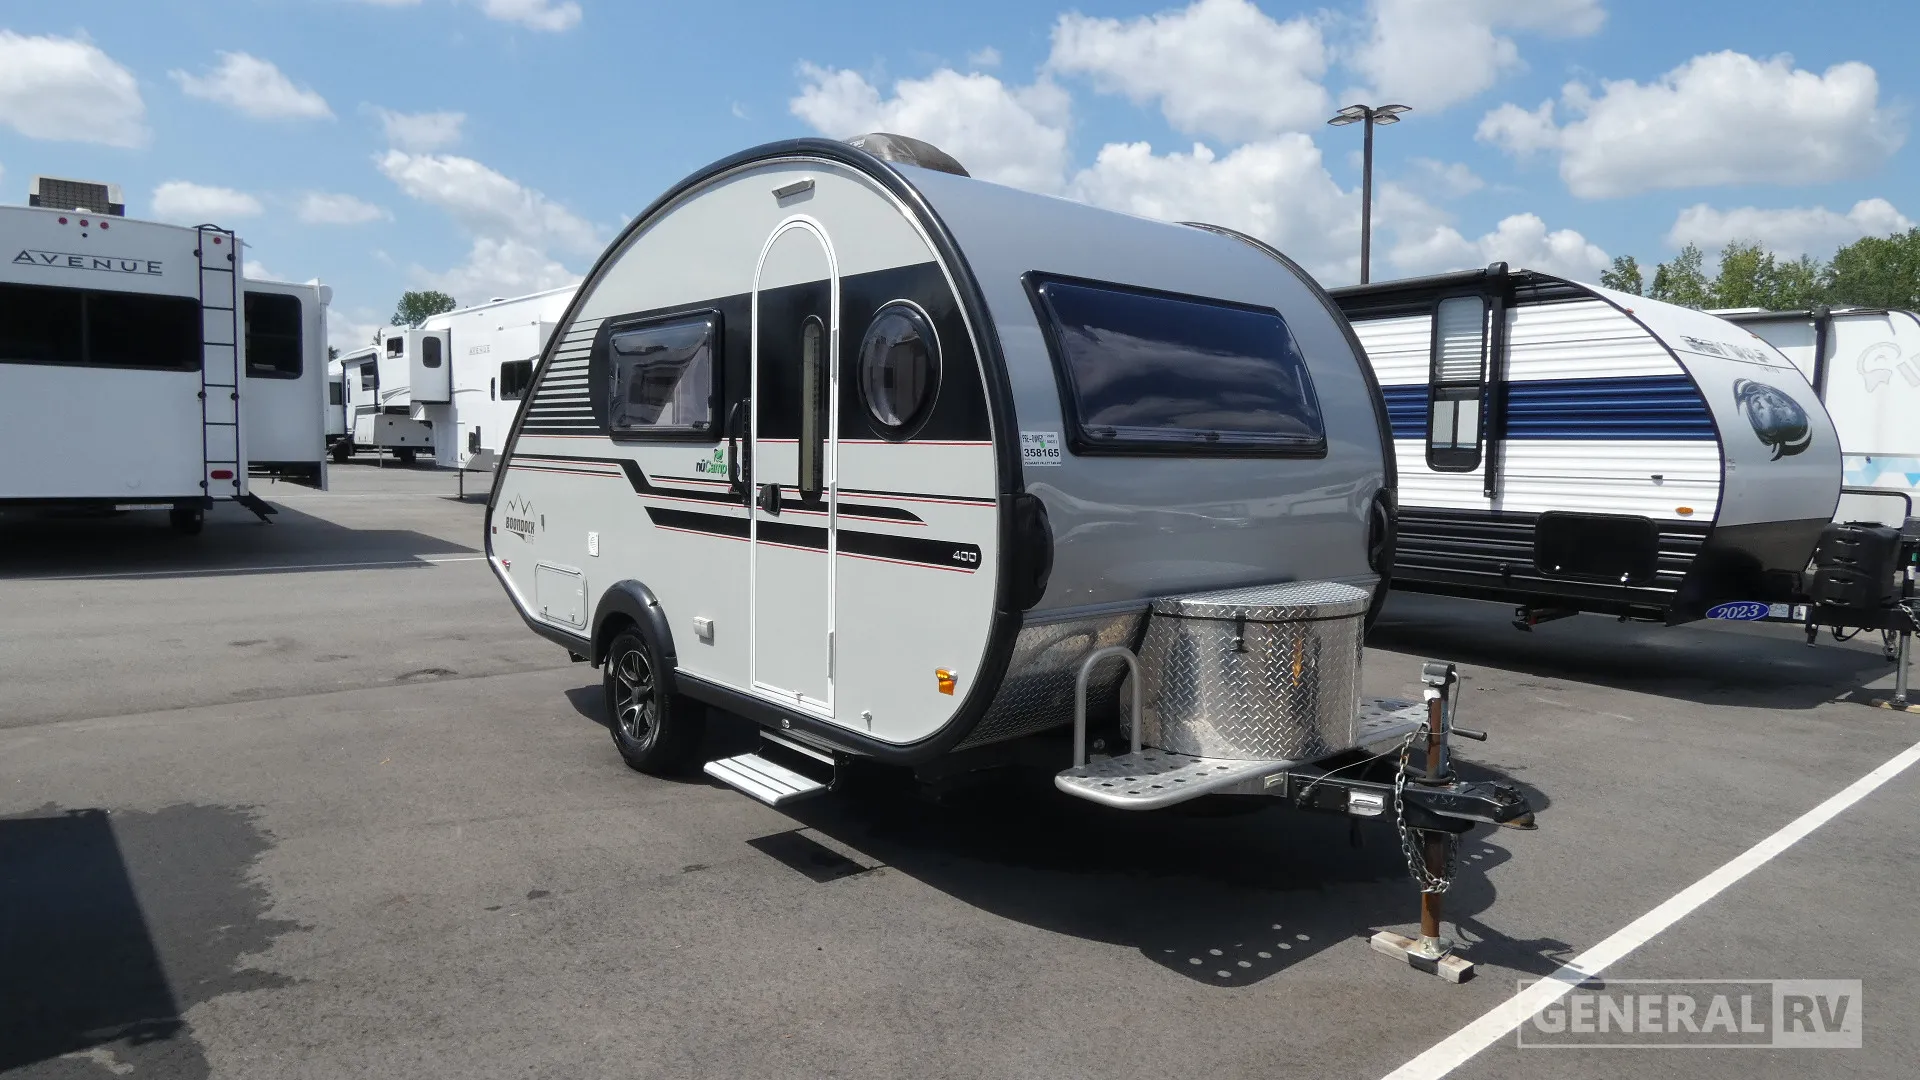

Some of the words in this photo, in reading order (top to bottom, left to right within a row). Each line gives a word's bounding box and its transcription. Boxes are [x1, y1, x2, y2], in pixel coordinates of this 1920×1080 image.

[12, 249, 163, 276] AVENUE
[1023, 448, 1060, 457] 358165
[505, 516, 536, 535] BOONDOCK
[953, 550, 976, 562] 400
[1717, 604, 1760, 619] 2023
